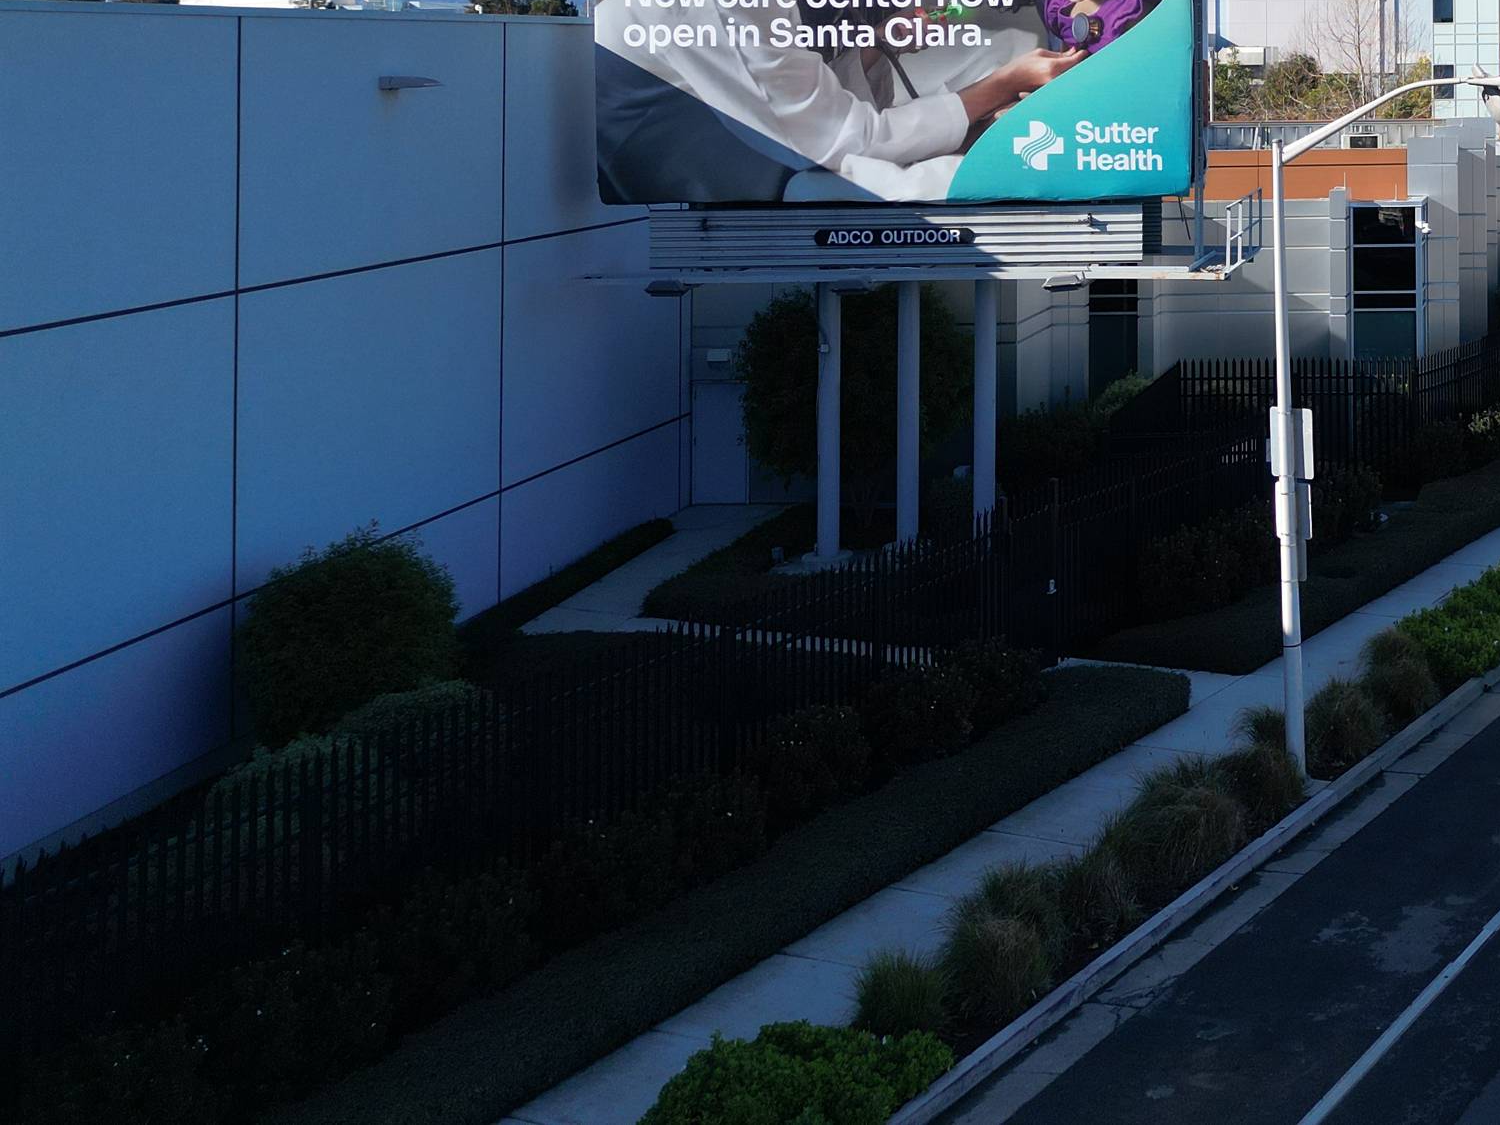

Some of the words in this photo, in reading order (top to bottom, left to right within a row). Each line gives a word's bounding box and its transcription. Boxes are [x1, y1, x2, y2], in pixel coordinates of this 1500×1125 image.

[624, 22, 718, 54] open
[727, 18, 760, 48] in
[769, 18, 875, 48] Santa
[885, 17, 991, 48] Clara.
[1075, 120, 1159, 144] Sutter
[1077, 148, 1163, 171] Health
[827, 230, 874, 244] ADCO
[881, 229, 961, 244] OUTDOOR
